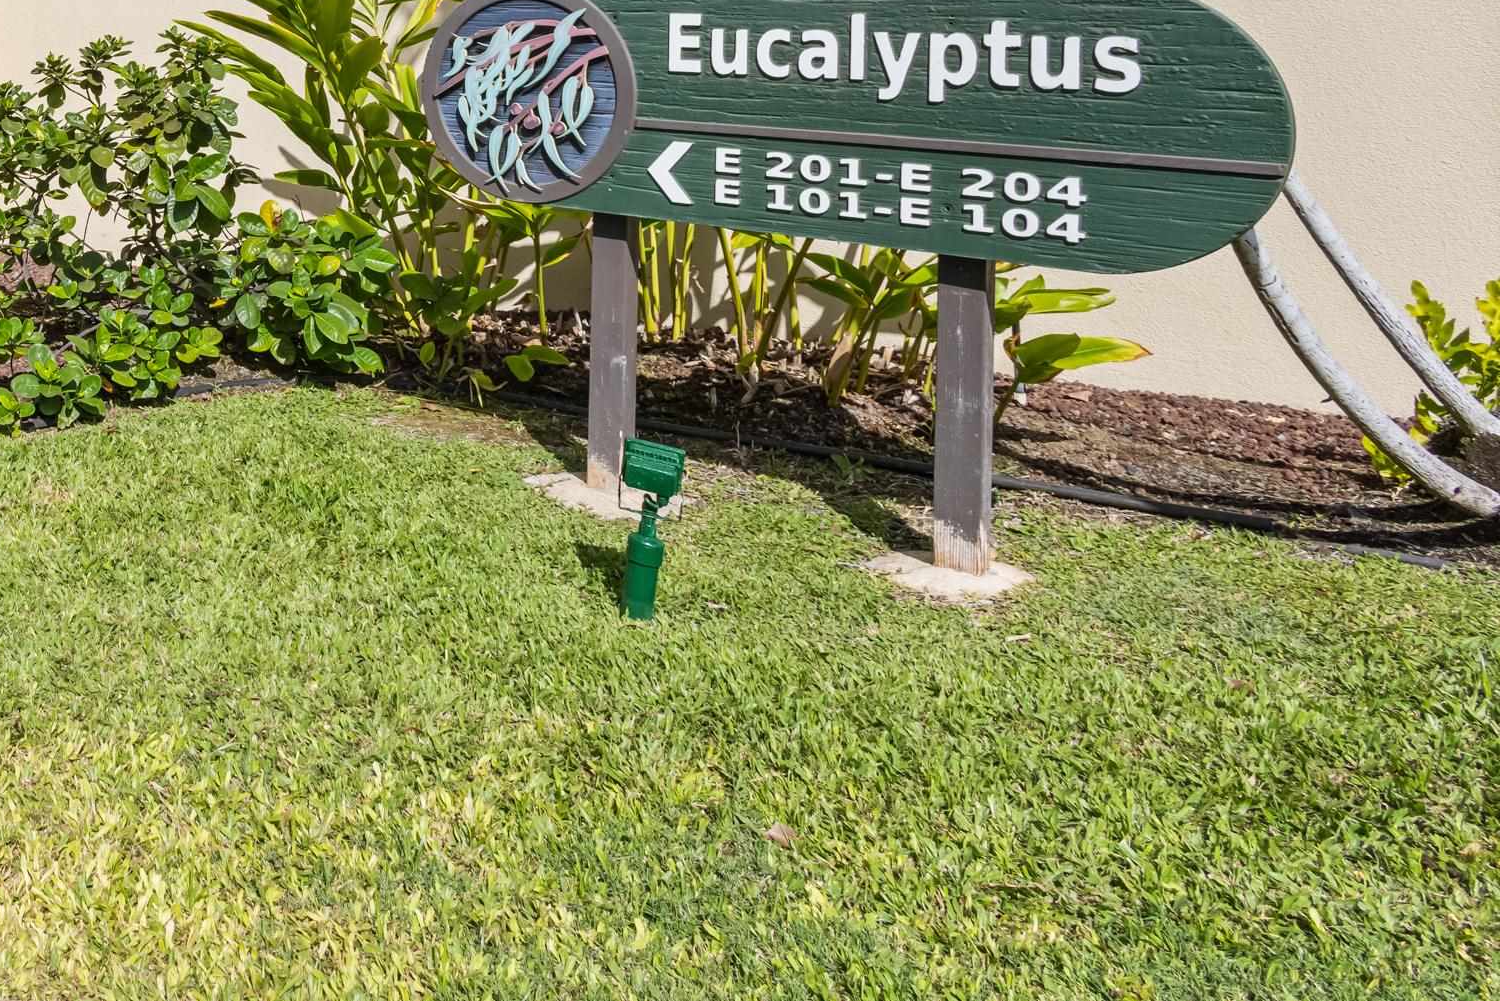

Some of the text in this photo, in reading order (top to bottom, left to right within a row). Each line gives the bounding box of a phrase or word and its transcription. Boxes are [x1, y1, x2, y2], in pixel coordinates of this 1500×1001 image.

[668, 13, 1142, 102] Eucalyptus
[715, 148, 1087, 207] E 201-E 204
[715, 179, 1086, 243] E 101-E 104
